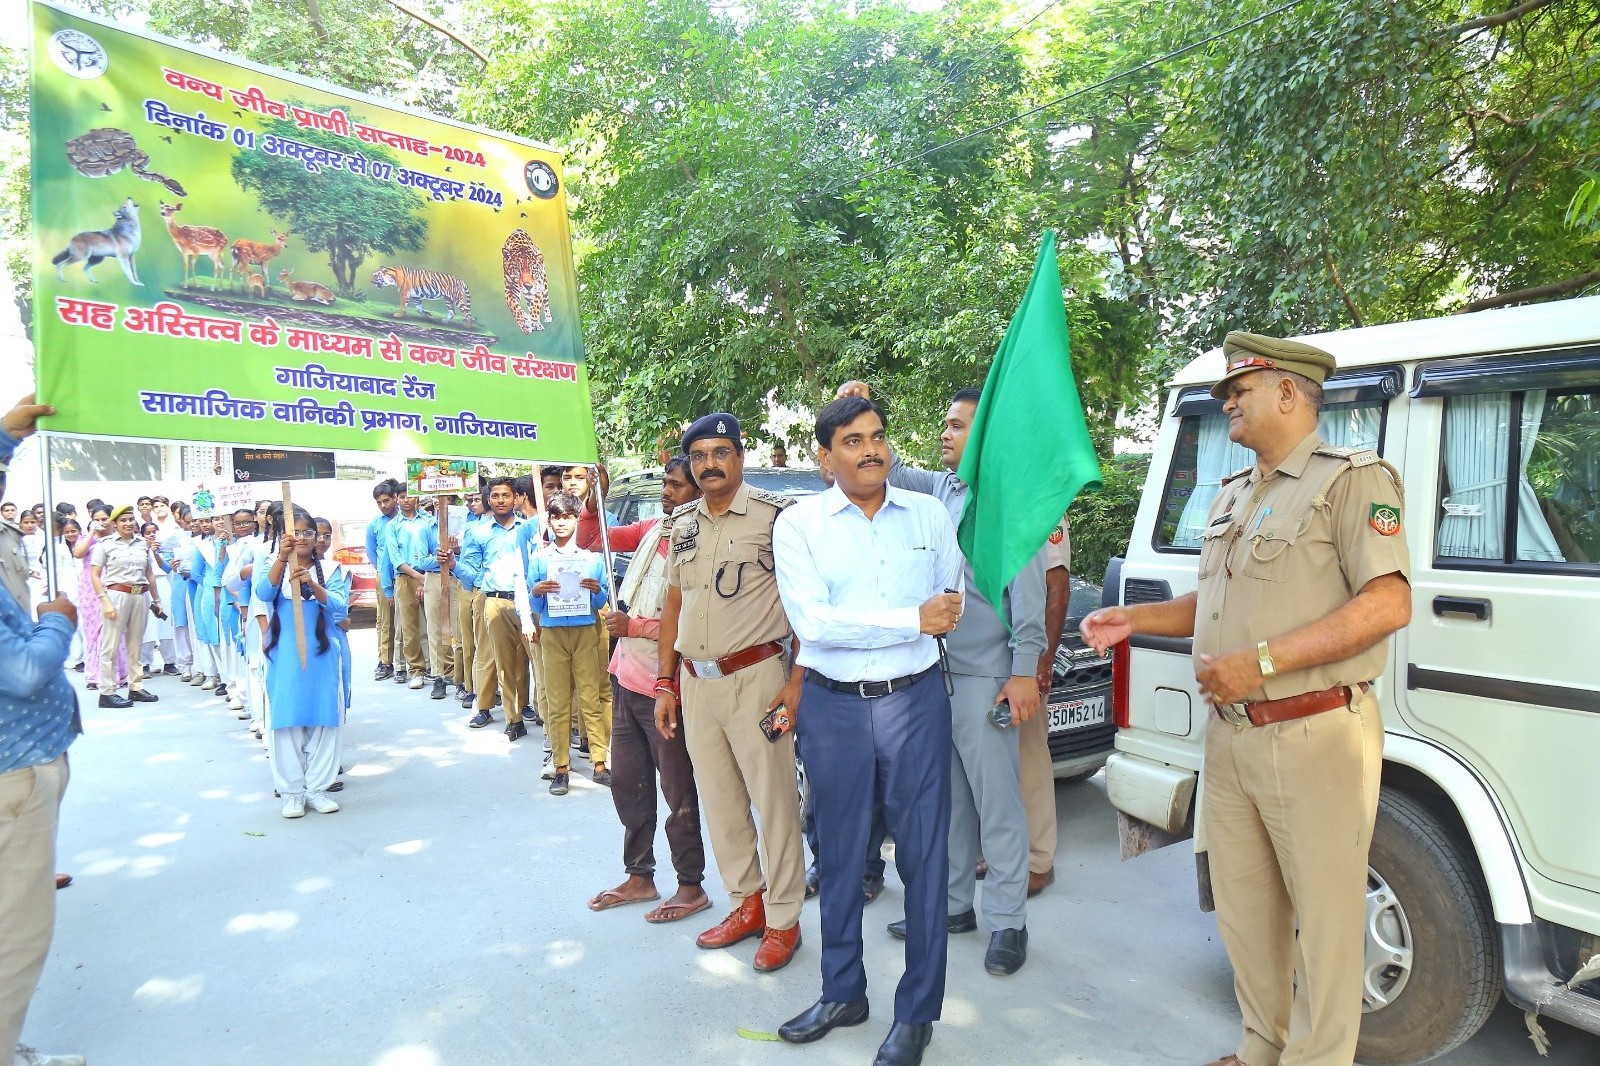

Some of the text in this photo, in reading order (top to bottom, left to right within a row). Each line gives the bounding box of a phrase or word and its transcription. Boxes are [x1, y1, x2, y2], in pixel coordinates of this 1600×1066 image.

[163, 68, 224, 101] वन्य
[229, 87, 288, 119] जीव
[292, 108, 350, 136] प्राणी
[145, 101, 503, 207] दिनांक 01 अक्टूबर से 07 अक्टूबर 2024
[58, 298, 577, 382] सह अस्तित्व के माध्यम से वन्य जीव संरक्षण
[140, 390, 538, 440] सामाजिक वानिकी प्रभाग, गाजियाबाद
[275, 364, 436, 399] गाजियाबाद रेंज
